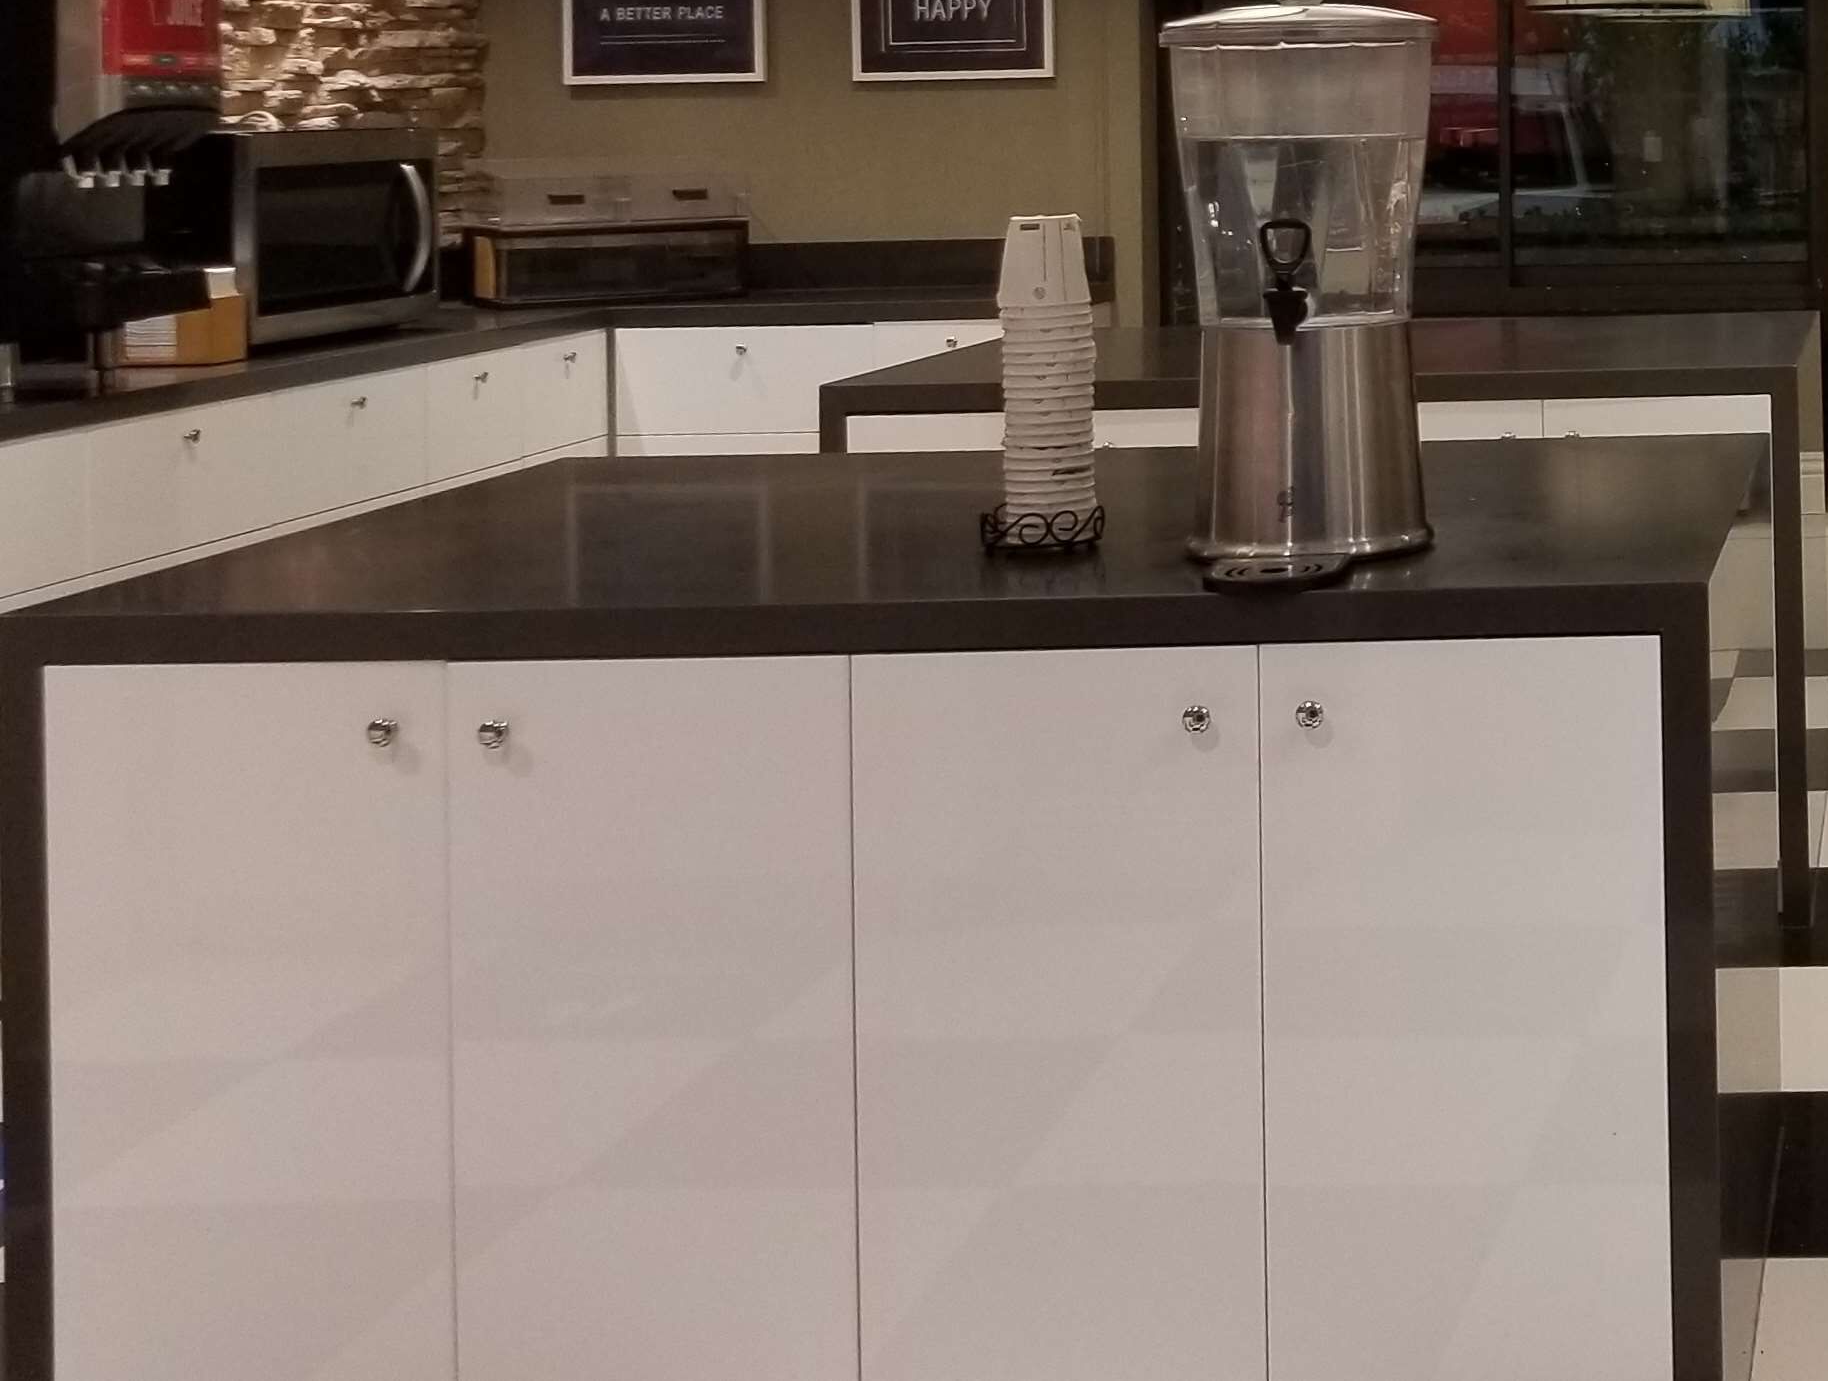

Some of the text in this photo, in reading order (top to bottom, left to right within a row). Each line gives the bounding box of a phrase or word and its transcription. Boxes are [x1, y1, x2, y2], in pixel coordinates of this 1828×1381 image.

[600, 5, 724, 22] A BETTER PLACE
